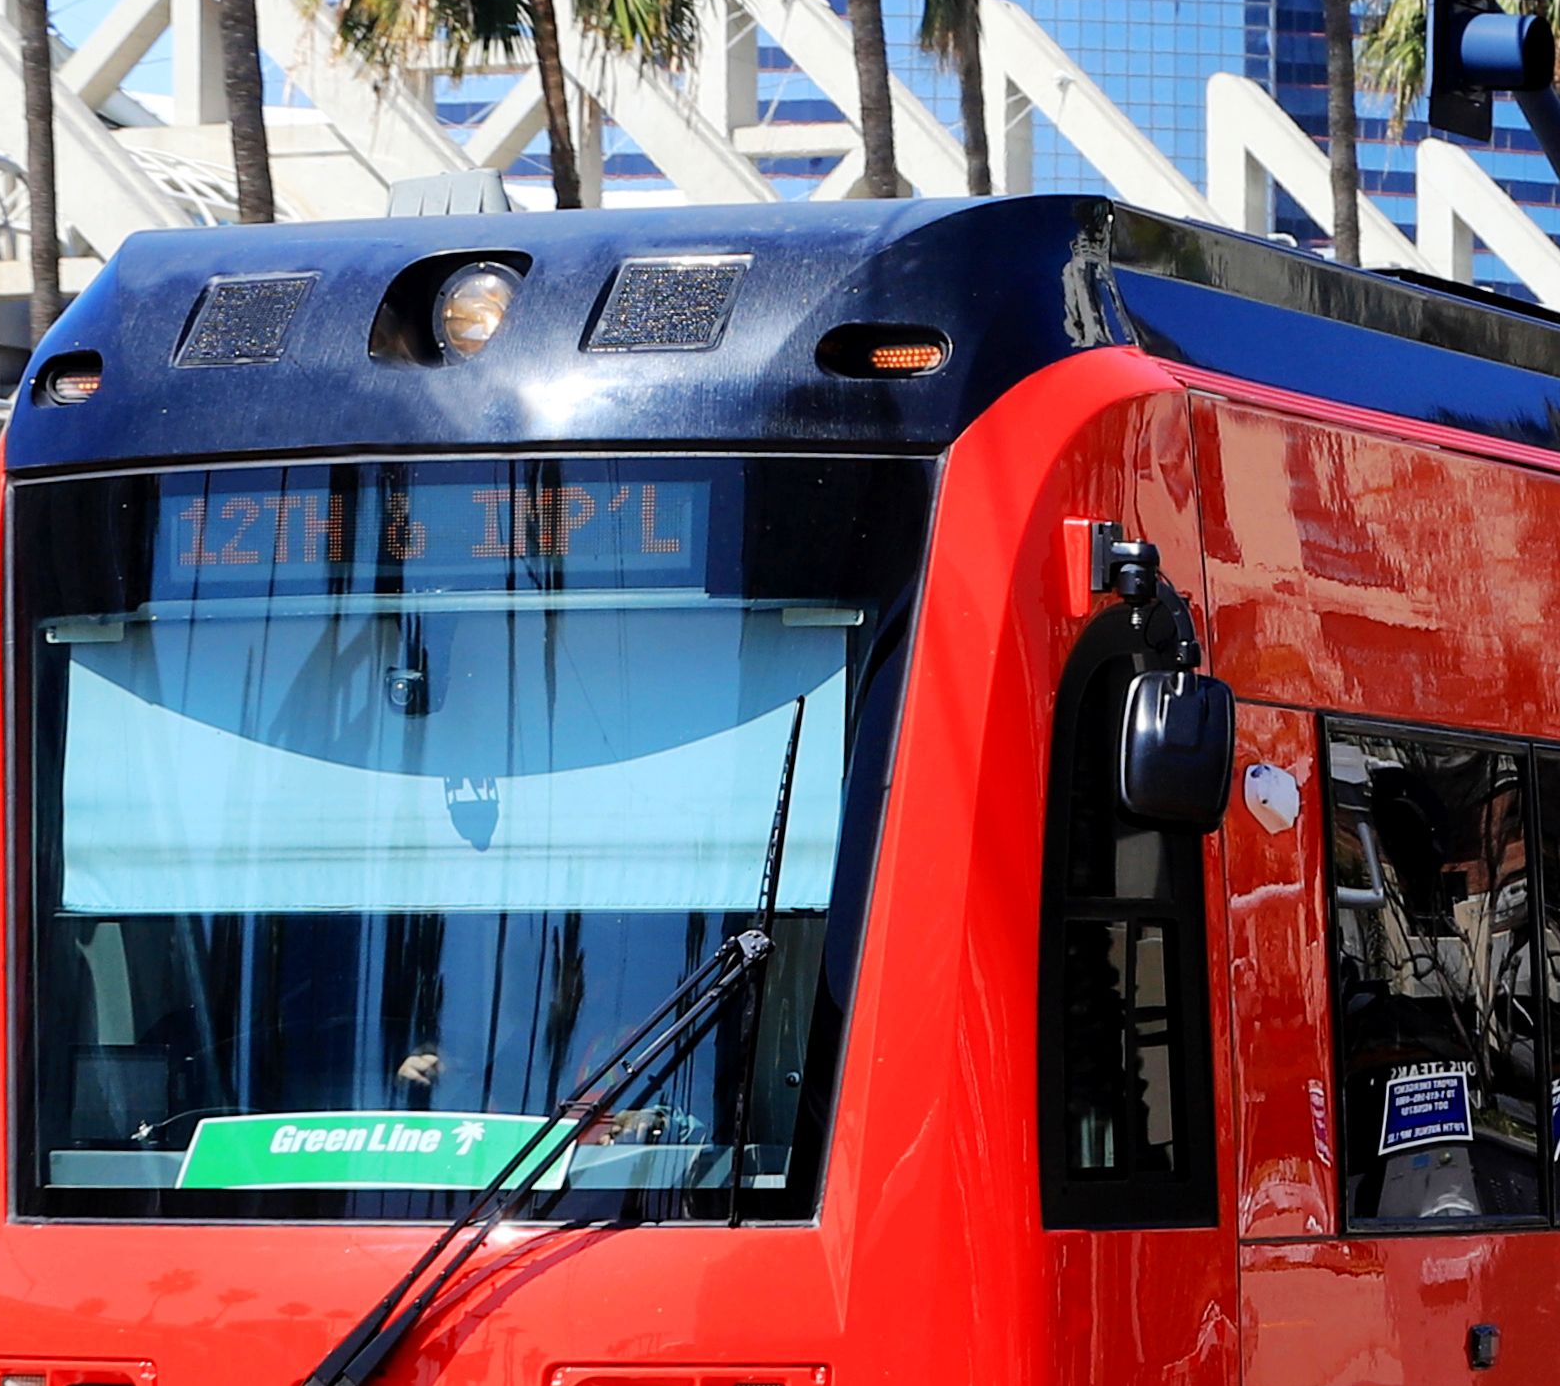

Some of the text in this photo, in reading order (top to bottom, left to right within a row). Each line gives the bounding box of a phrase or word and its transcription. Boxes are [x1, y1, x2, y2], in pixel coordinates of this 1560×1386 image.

[179, 493, 343, 566] 12TH
[269, 1123, 442, 1154] Green Line
